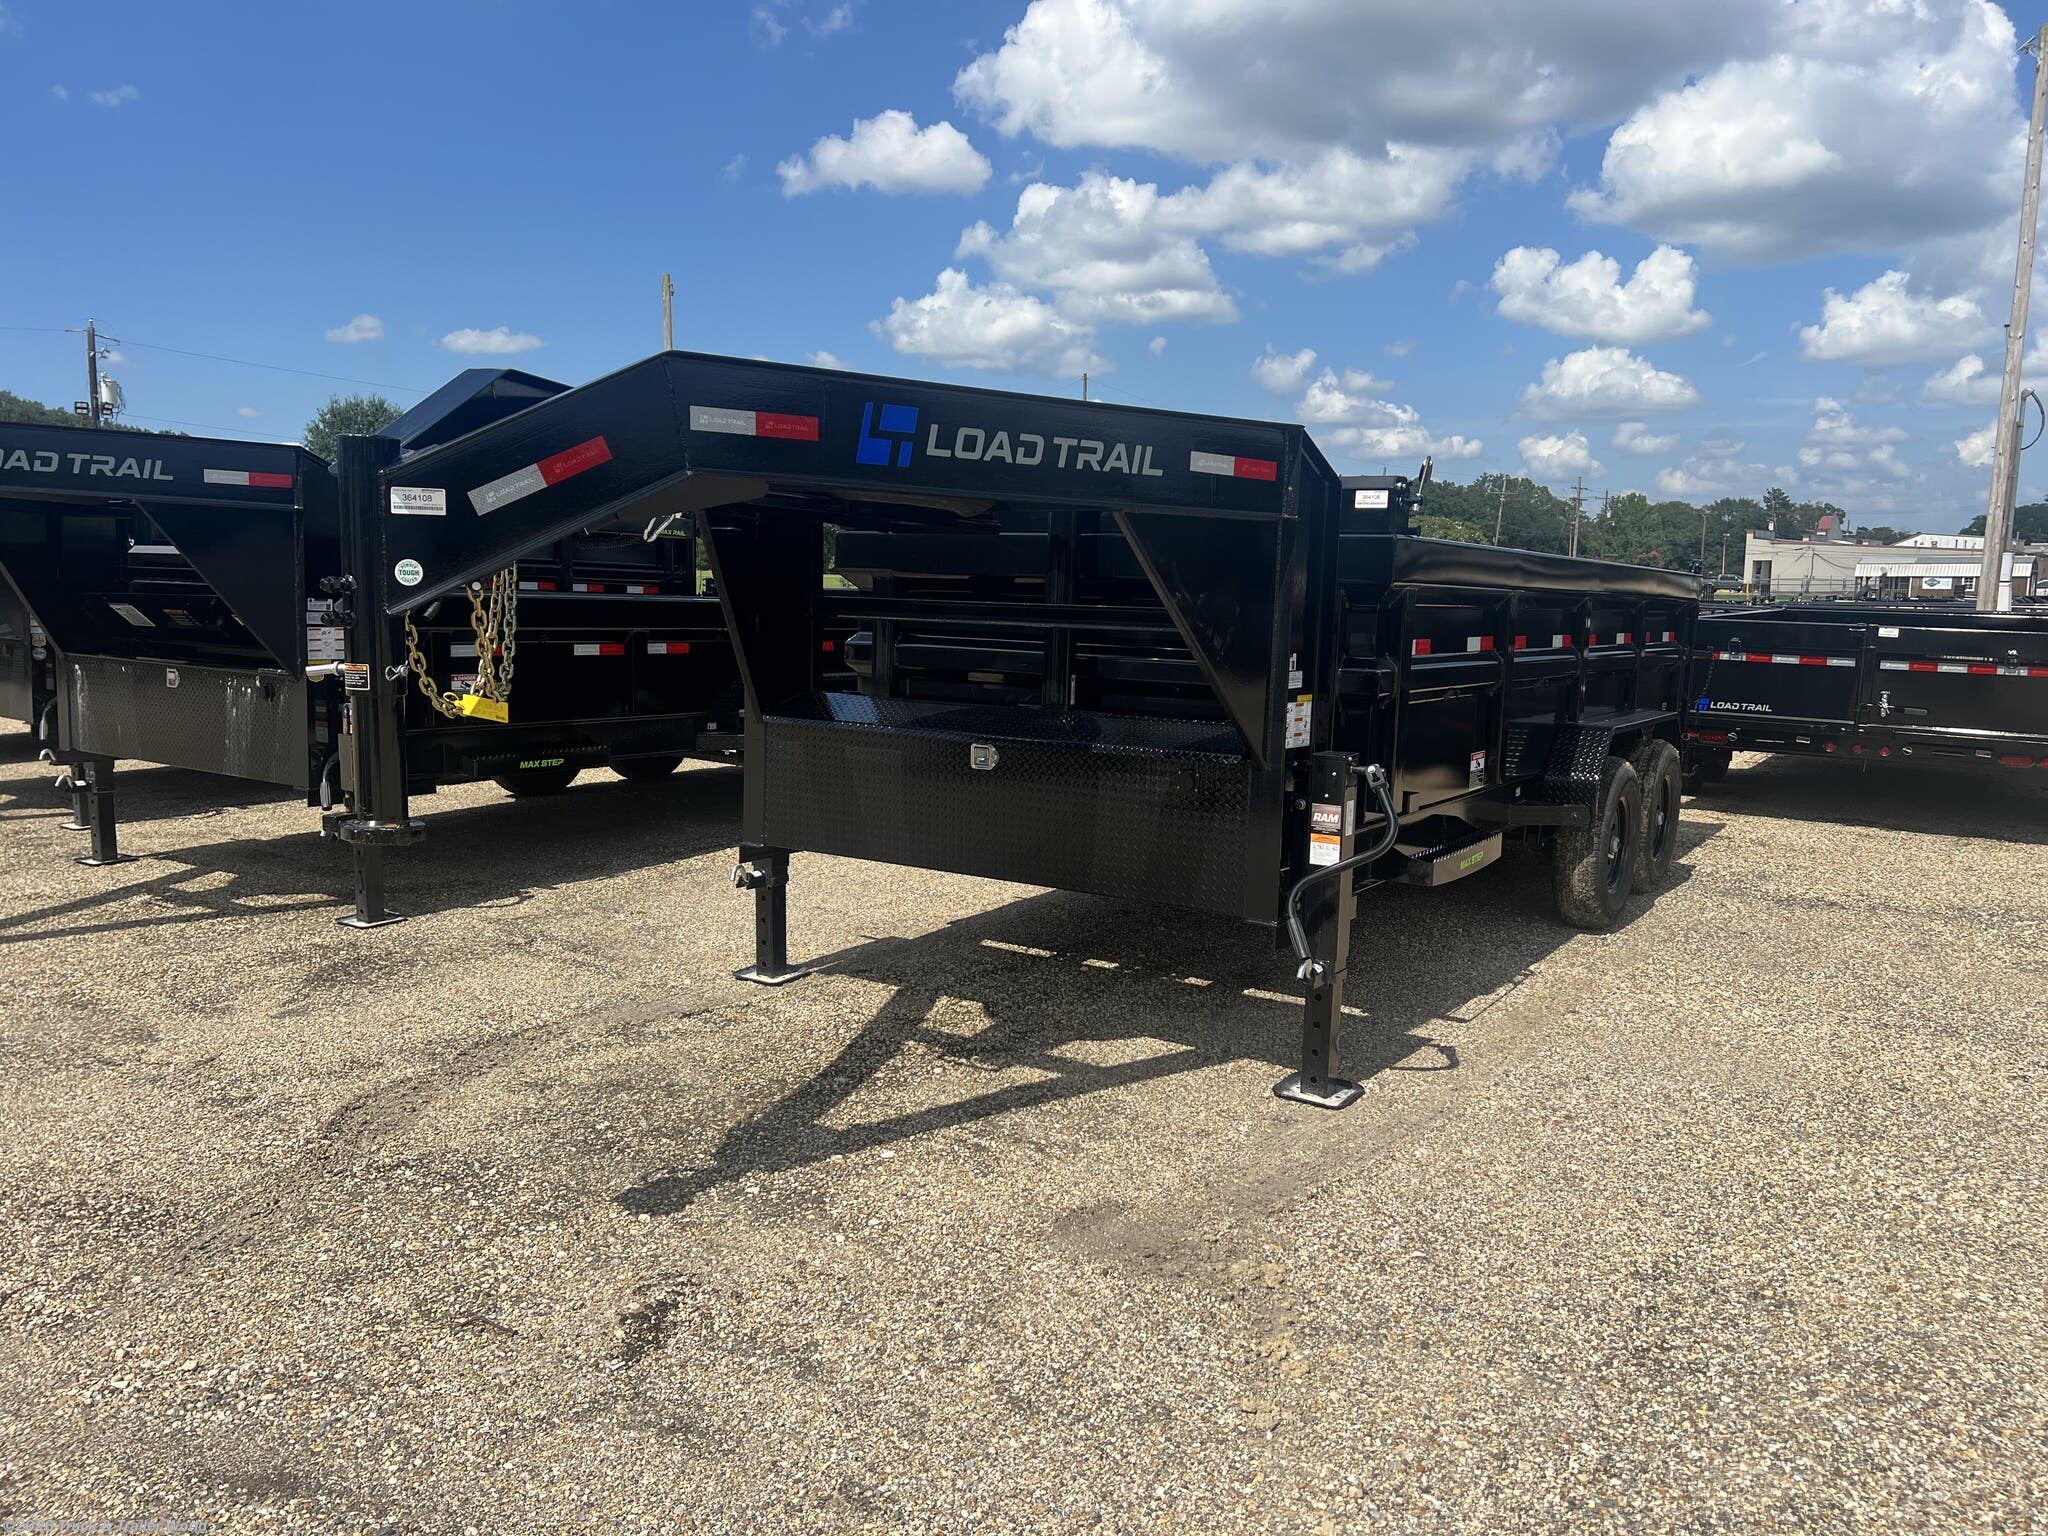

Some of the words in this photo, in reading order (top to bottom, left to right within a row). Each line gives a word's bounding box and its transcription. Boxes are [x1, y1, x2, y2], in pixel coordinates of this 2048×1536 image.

[926, 423, 1045, 466] LOAD
[1053, 436, 1164, 476] TRAIL
[0, 449, 59, 472] AD
[66, 453, 174, 481] TRAIL
[401, 493, 433, 502] 364108
[1710, 701, 1740, 710] LOAD
[1741, 703, 1772, 712] TRAIL
[520, 760, 540, 769] MAX
[541, 758, 565, 767] STEP
[1313, 812, 1339, 824] RAM
